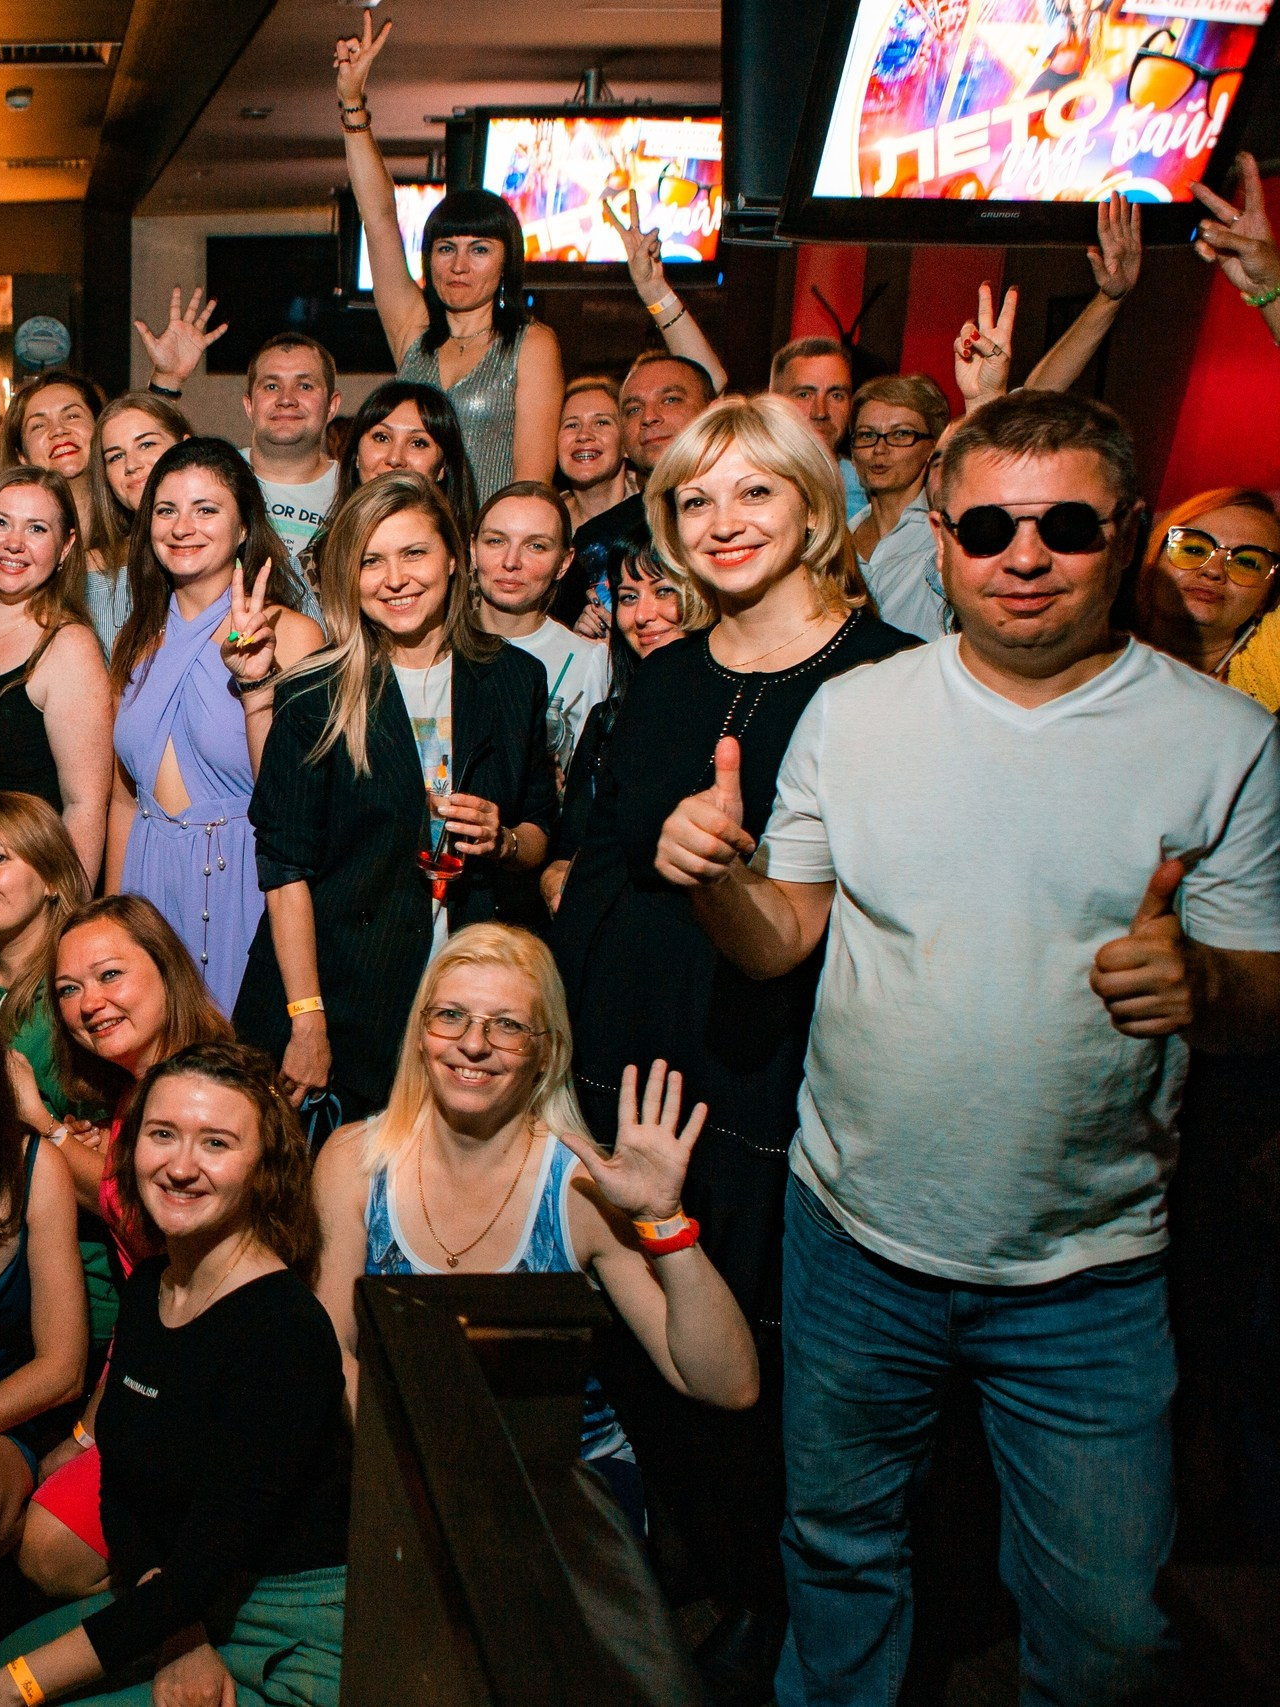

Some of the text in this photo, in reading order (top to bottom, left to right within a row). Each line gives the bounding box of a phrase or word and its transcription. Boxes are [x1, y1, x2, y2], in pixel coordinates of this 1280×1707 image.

[874, 78, 1114, 197] ЛЕТО
[980, 211, 1020, 219] GRUNDIG
[264, 502, 295, 518] LOR
[123, 1375, 159, 1398] MINIMALISM
